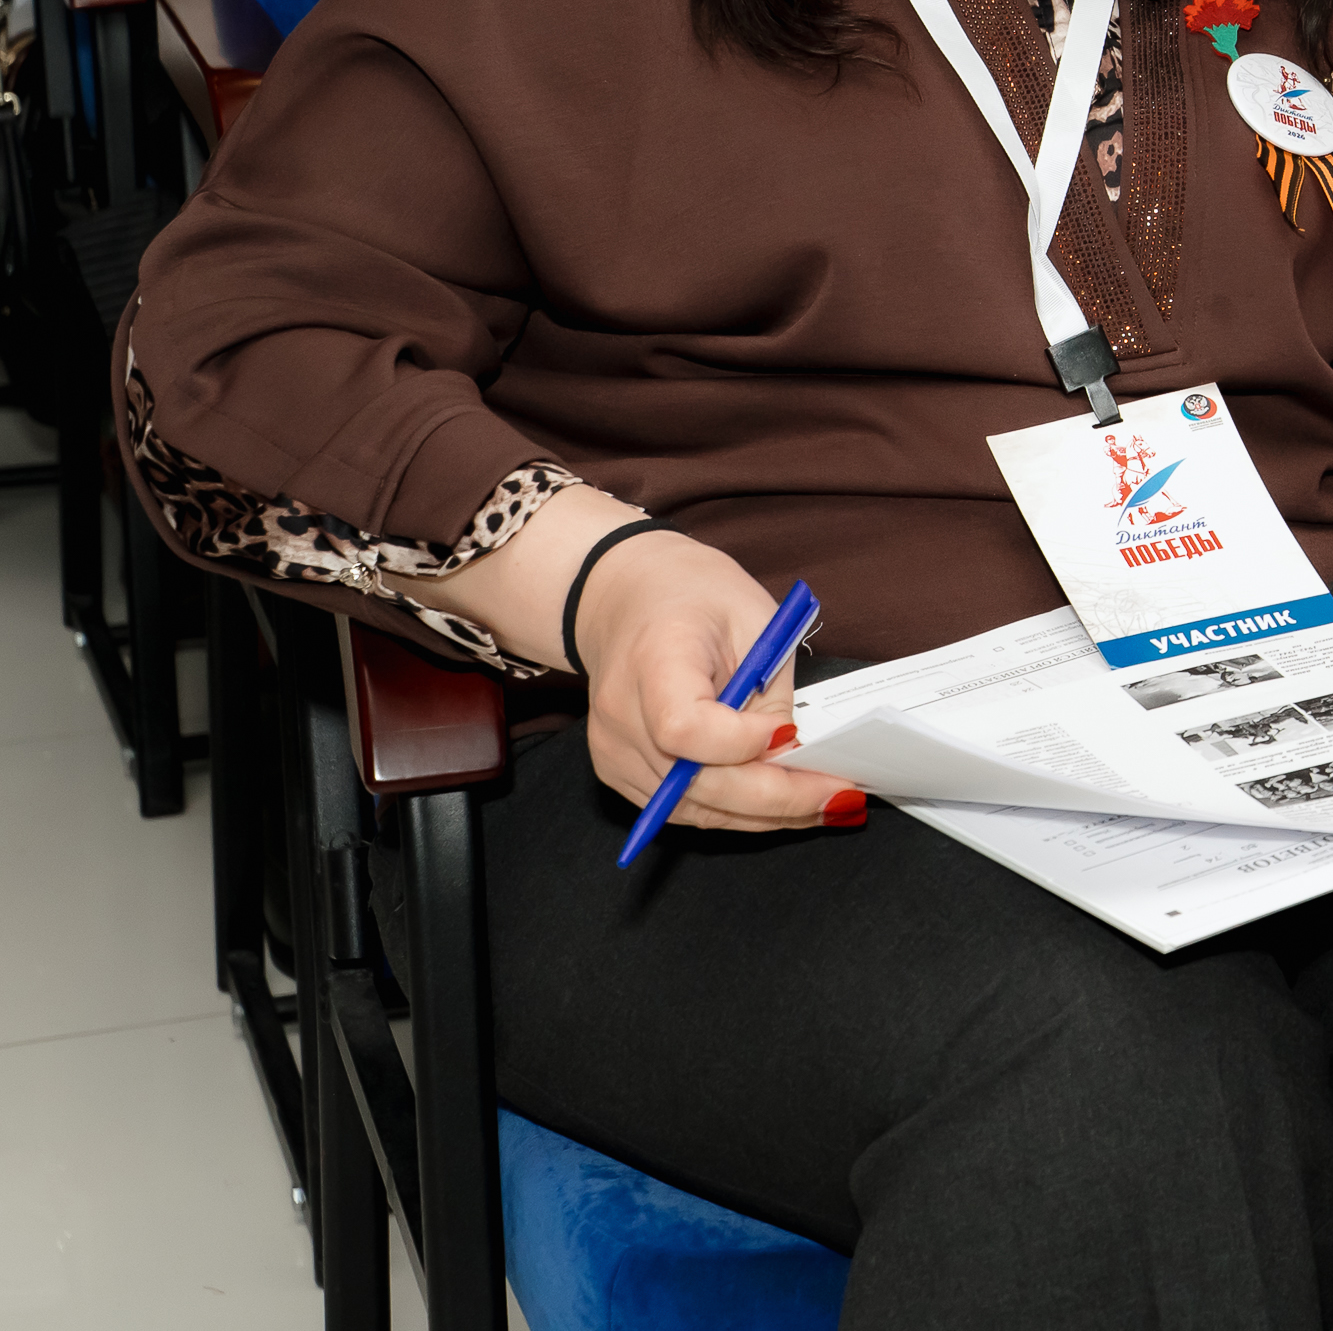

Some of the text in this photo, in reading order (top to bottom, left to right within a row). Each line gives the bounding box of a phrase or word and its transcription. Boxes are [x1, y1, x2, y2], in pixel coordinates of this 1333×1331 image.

[1273, 103, 1314, 121] Диктант
[1273, 111, 1317, 134] ПОБЕДЫ
[1287, 130, 1306, 140] 2026
[1115, 517, 1208, 545] Диктант
[1120, 530, 1223, 568] ПОБЕДЫ
[1150, 609, 1297, 655] УЧАСТНИК
